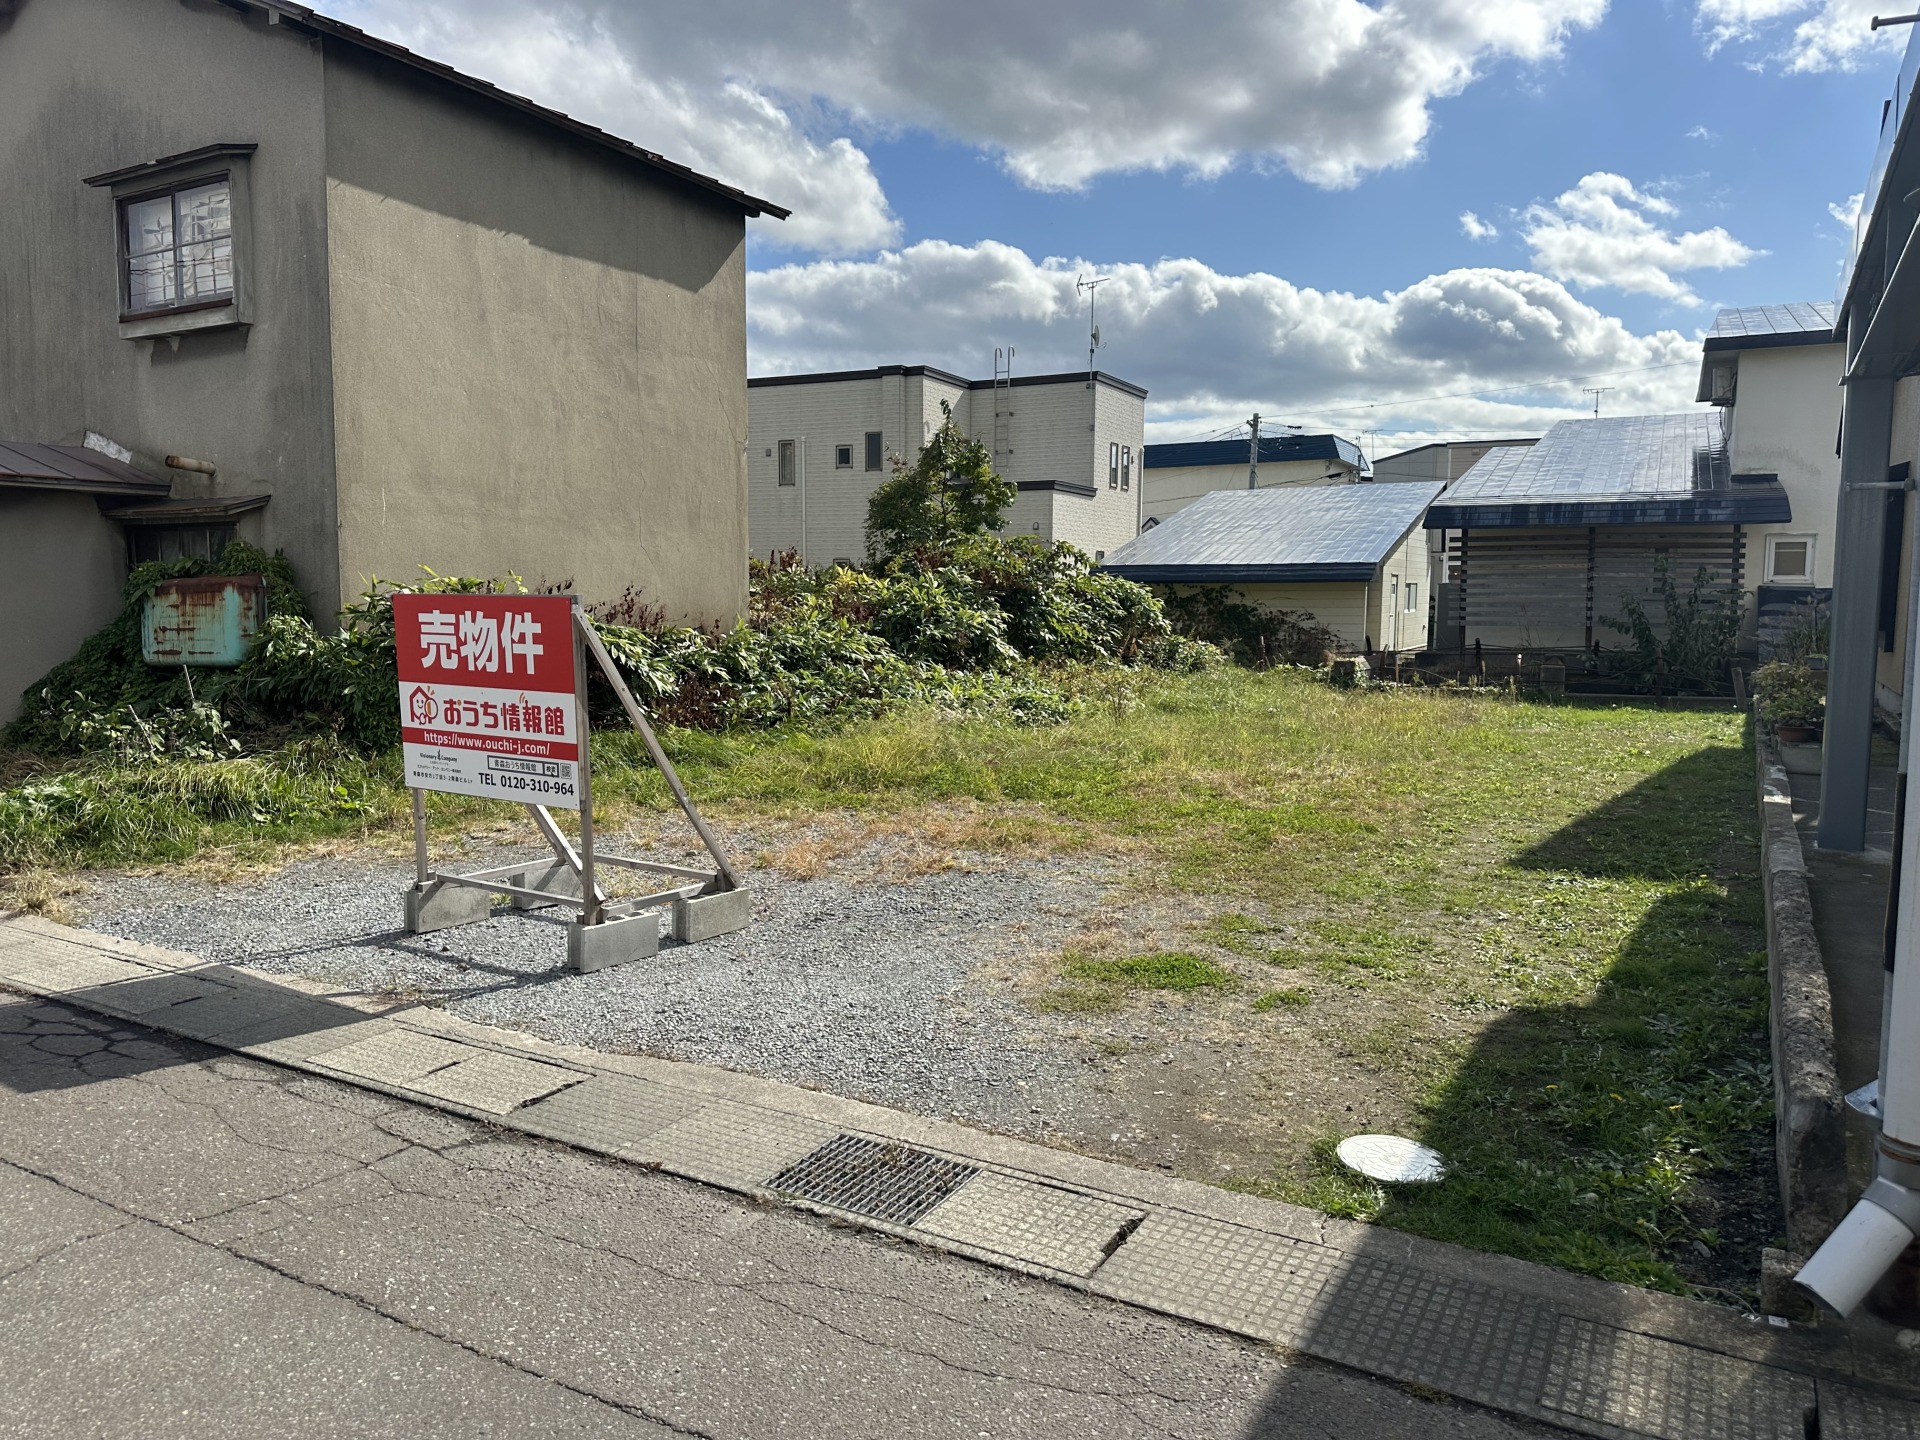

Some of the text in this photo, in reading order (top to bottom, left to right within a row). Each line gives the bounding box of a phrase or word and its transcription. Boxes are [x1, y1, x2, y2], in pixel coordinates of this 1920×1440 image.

[418, 609, 544, 674] 売物件
[443, 698, 565, 736] おうち情報館
[424, 731, 550, 755] https://www.ouchi-j.com/
[478, 772, 575, 796] TEL 0120-310-964
